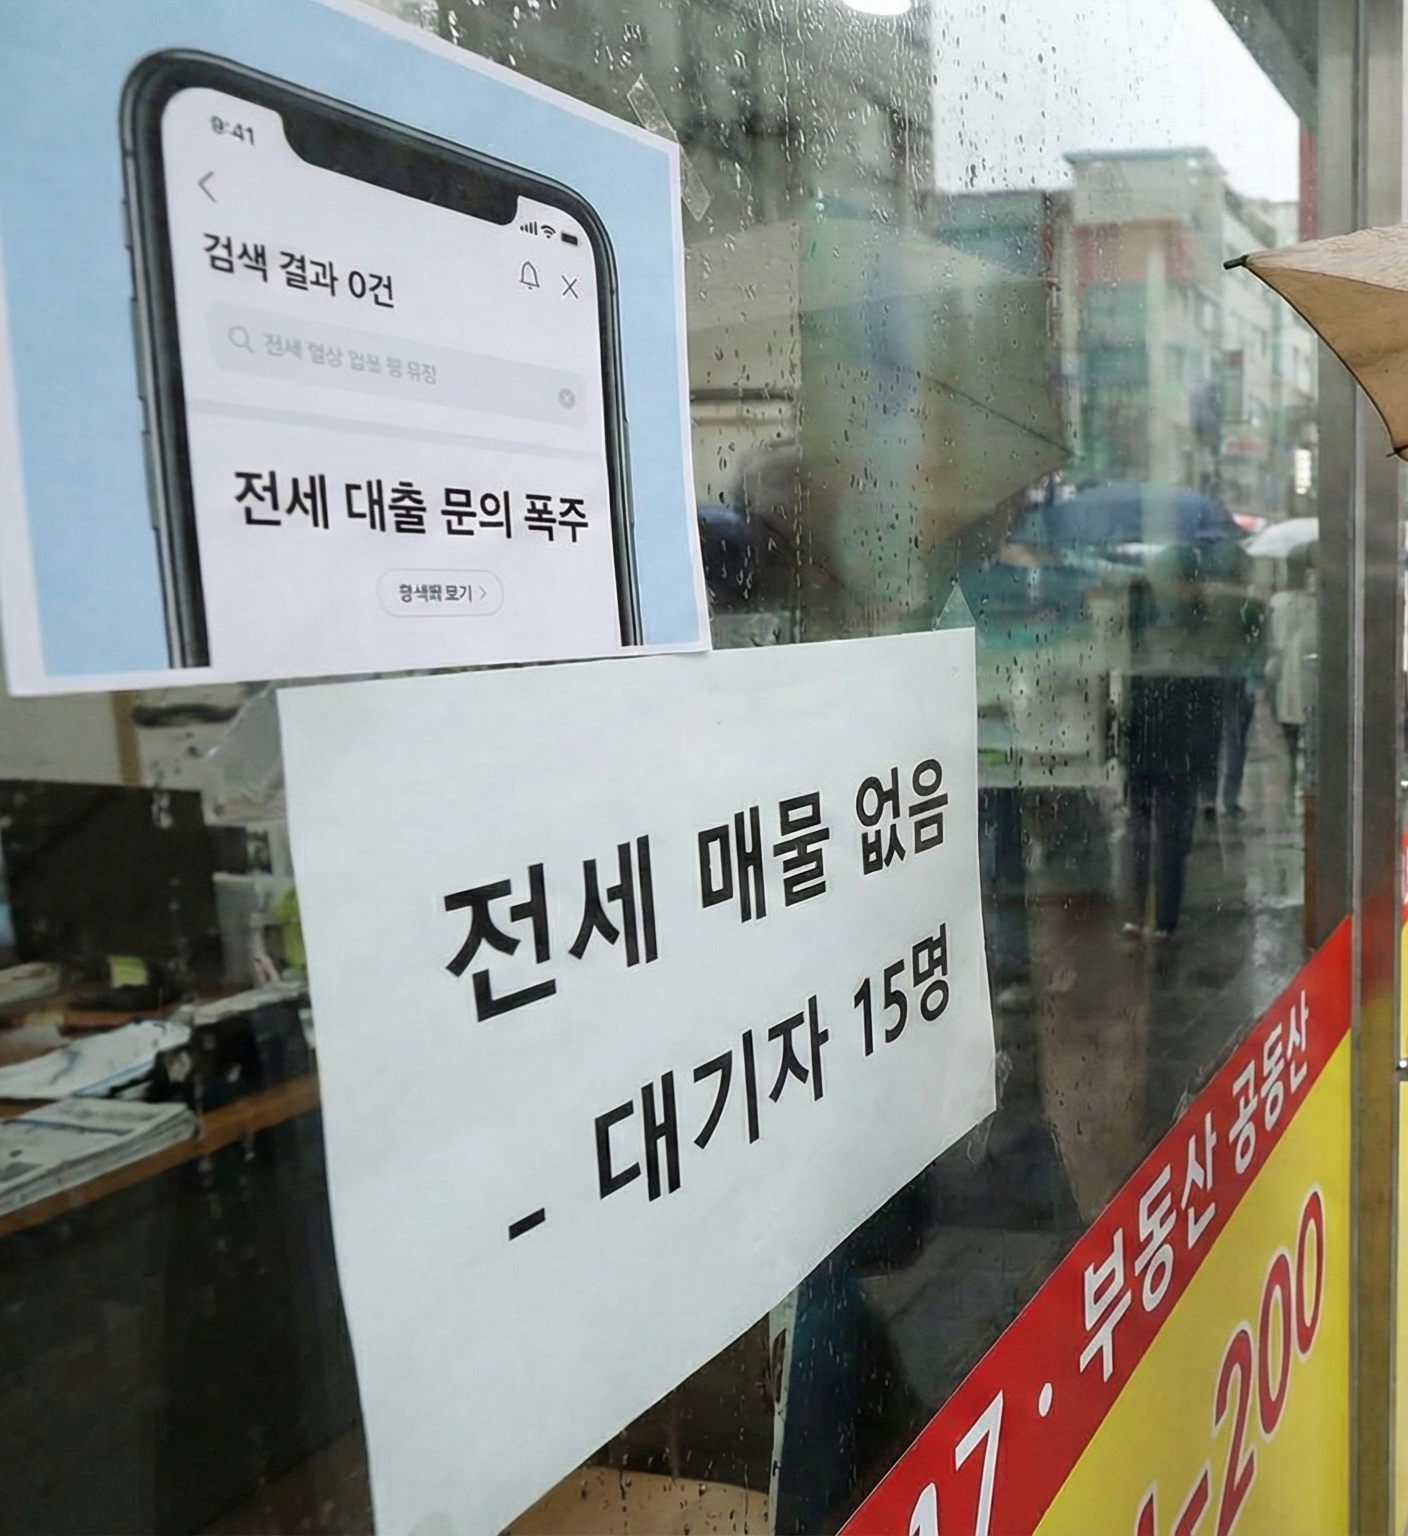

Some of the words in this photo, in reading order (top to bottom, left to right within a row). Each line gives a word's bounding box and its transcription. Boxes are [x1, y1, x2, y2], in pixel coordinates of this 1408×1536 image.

[203, 232, 269, 283] 검색
[279, 250, 339, 297] 결과
[347, 270, 395, 309] 0건
[234, 470, 330, 530] 전세
[344, 478, 428, 535] 대출
[440, 487, 512, 540] 문의
[523, 493, 589, 543] 폭주
[443, 834, 659, 1023] 전세
[697, 791, 831, 924] 매물
[855, 758, 949, 876] 없음
[594, 994, 830, 1202] 대기자
[853, 922, 950, 1057] 15명
[1080, 1111, 1217, 1383] 부동산
[1229, 989, 1309, 1175] 공동산
